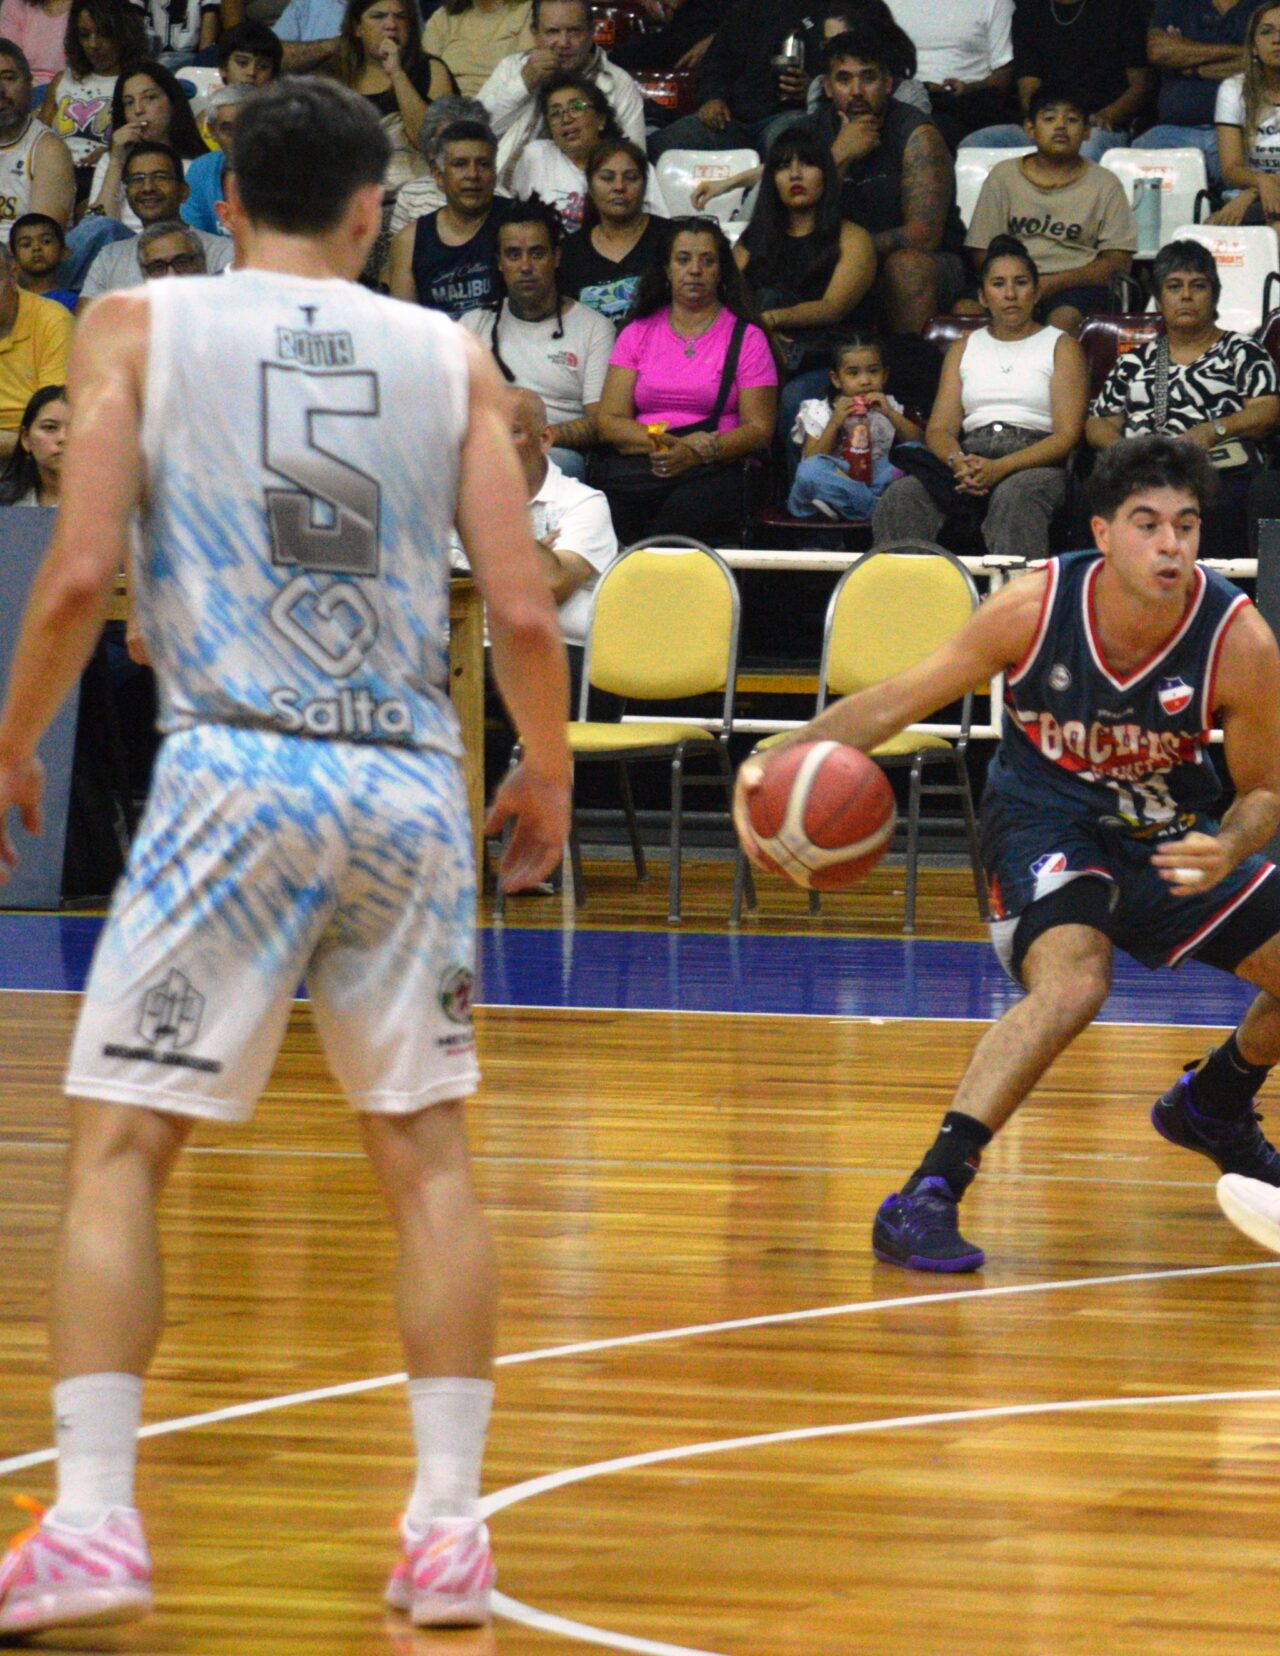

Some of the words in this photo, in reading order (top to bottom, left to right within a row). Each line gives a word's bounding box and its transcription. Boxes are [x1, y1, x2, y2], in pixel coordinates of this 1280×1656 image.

[431, 278, 492, 303] MALIBU
[260, 360, 380, 578] 5
[270, 686, 415, 735] Salta
